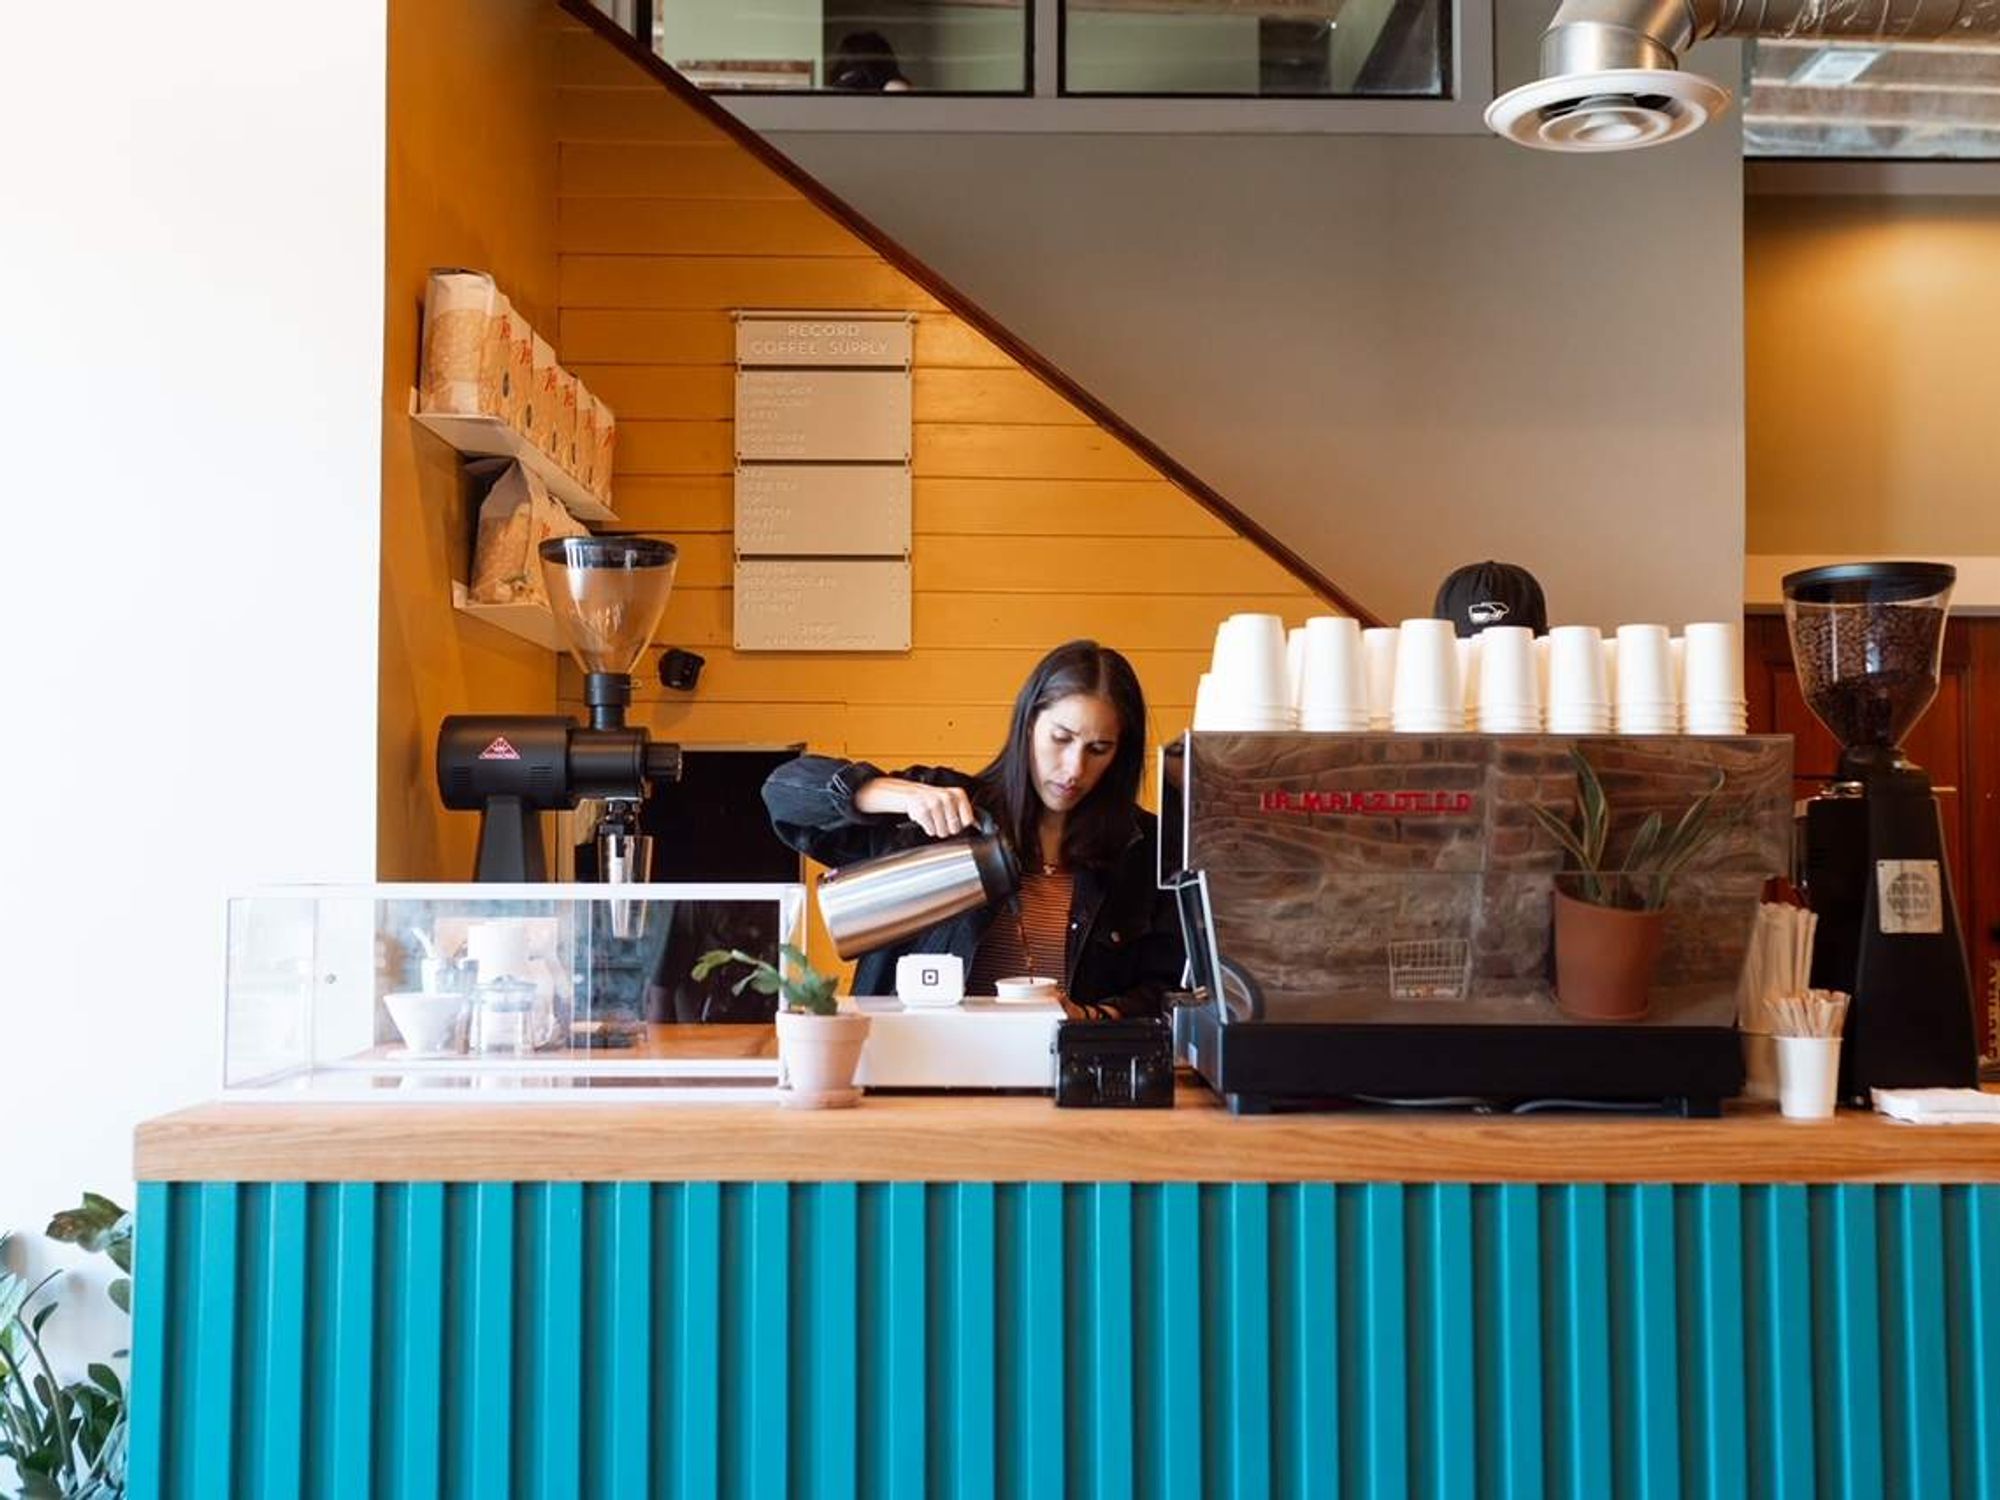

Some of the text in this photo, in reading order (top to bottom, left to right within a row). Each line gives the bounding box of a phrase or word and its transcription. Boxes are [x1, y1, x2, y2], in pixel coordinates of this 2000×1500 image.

[787, 324, 860, 337] RECORD
[752, 340, 889, 354] COFFEE SUPPLY
